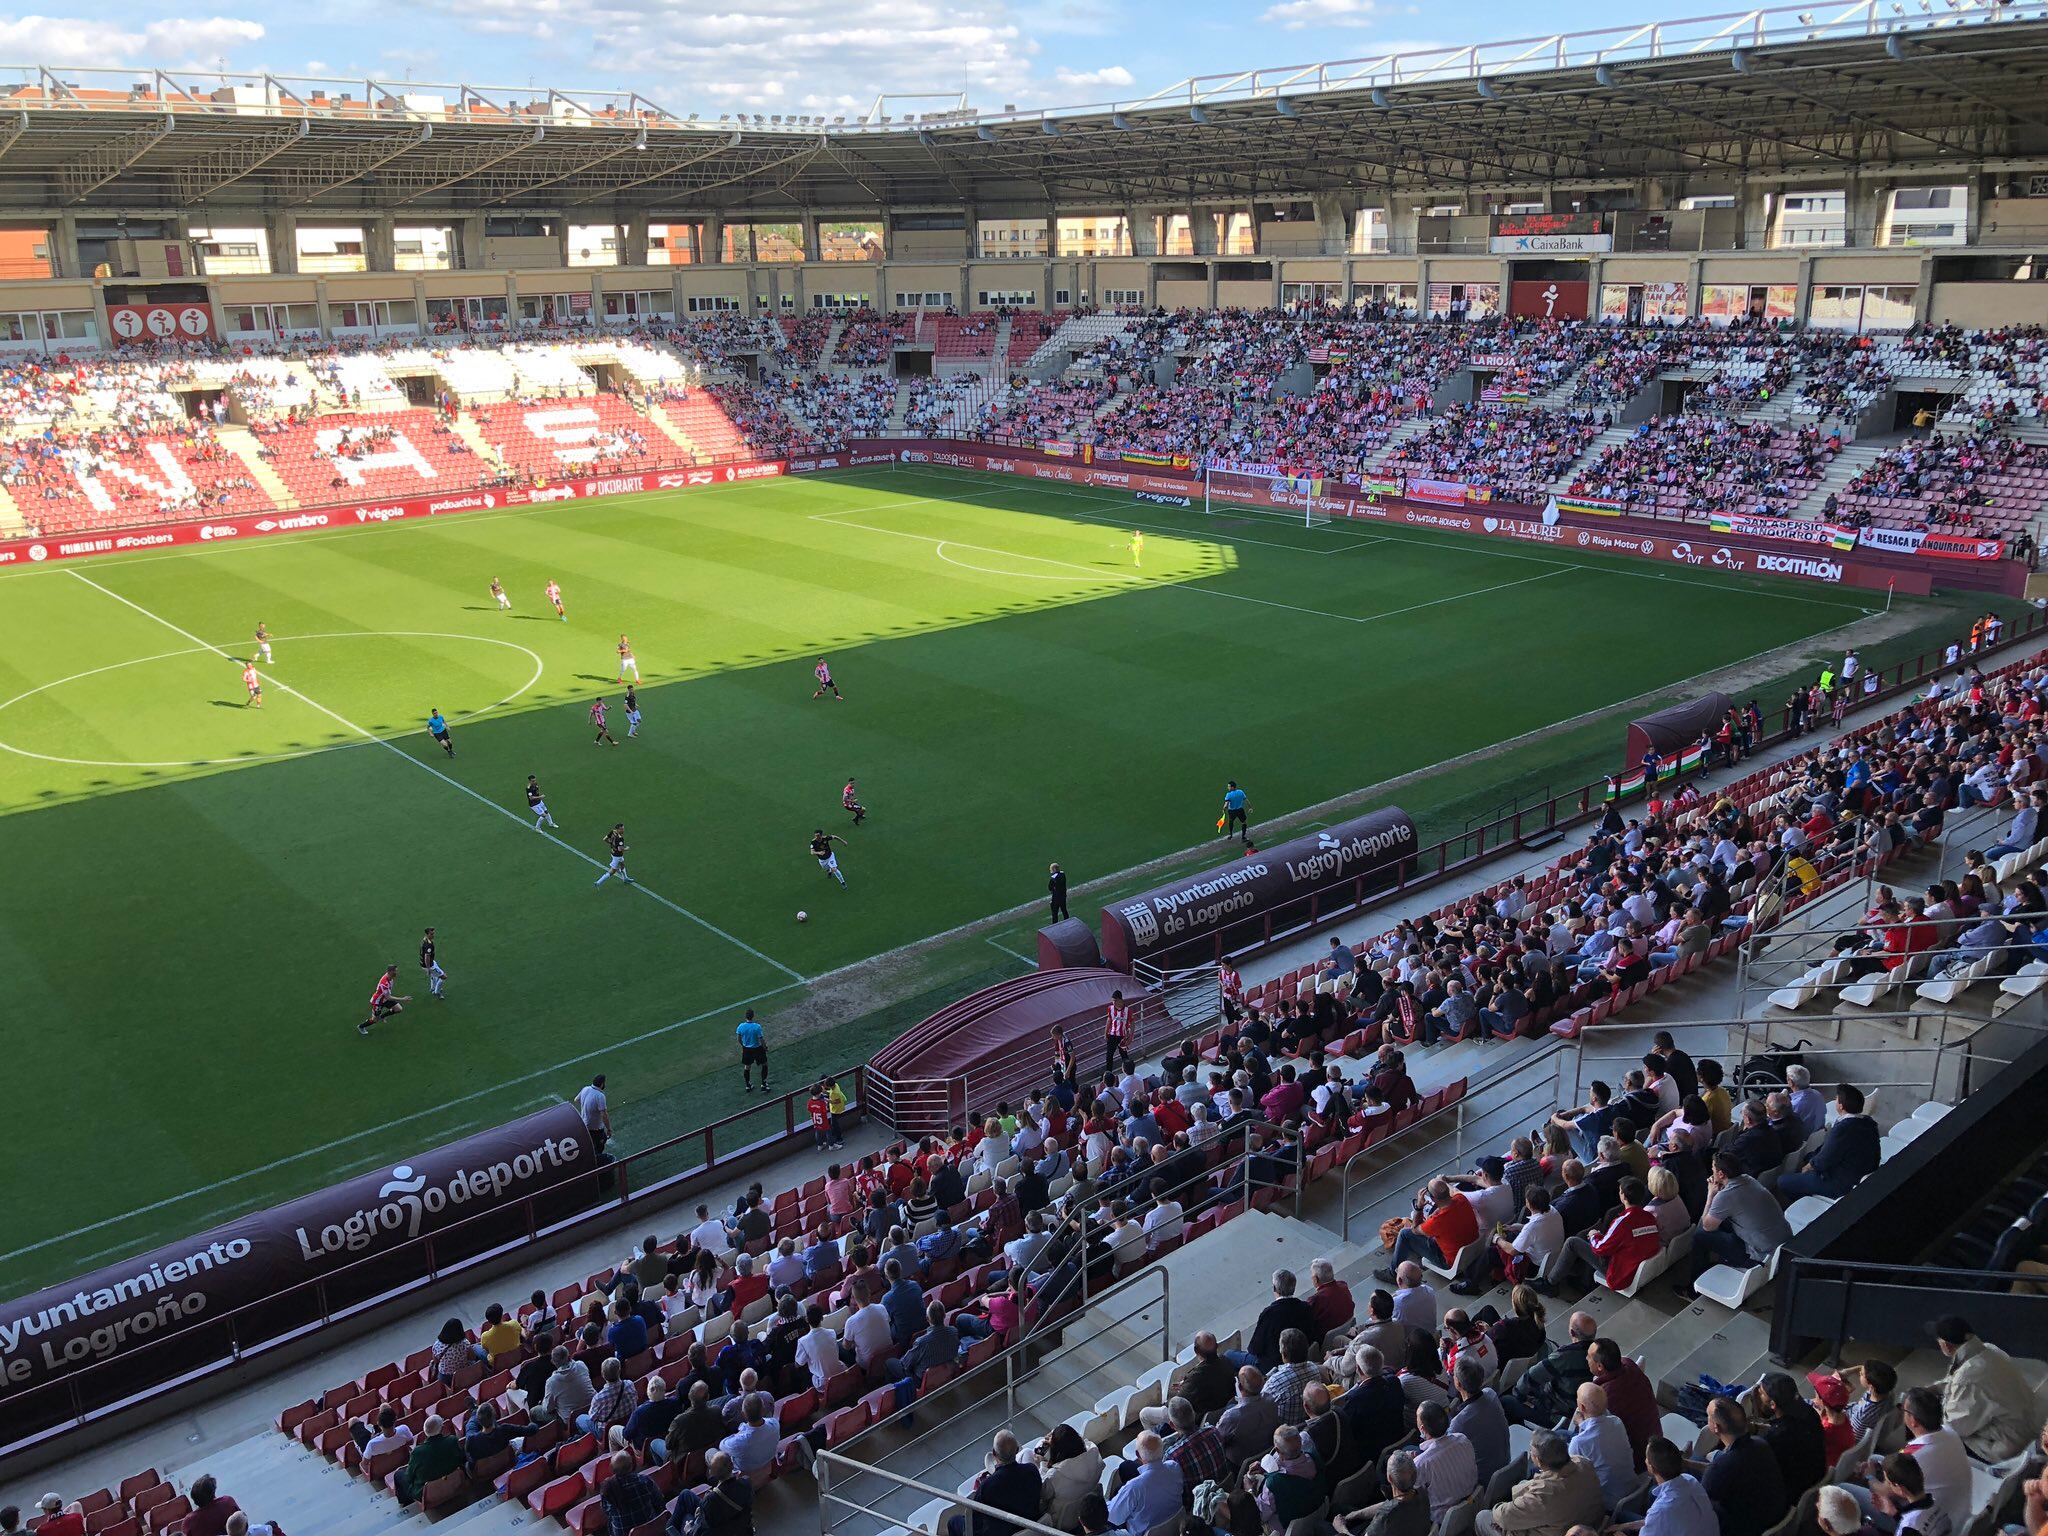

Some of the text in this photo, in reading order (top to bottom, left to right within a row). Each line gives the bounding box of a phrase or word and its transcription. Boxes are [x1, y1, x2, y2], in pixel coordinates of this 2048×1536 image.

[1531, 236, 1584, 251] CaixaBank
[1473, 356, 1516, 366] LA RIOJA
[1094, 472, 1129, 483] mayoral
[430, 497, 482, 514] podoactiva
[279, 514, 329, 530] umbro
[1499, 519, 1564, 539] LA LAUREL
[1744, 516, 1823, 532] SAN ASENSIO
[1736, 524, 1828, 543] BLANQUIRROJO
[60, 540, 95, 555] PRIMERA
[1592, 536, 1638, 550] Rioja Motor
[1876, 533, 1975, 555] RESACA BLANQUIRROJA
[1687, 552, 1704, 565] tvr
[1727, 558, 1745, 571] tvr
[1757, 554, 1842, 580] DECATHLON
[1153, 860, 1268, 915] Ayuntamiento
[1163, 887, 1254, 937] de Logroño
[812, 1112, 823, 1125] 15
[0, 1237, 251, 1354] yuntamiento
[41, 1292, 207, 1370] Logroño
